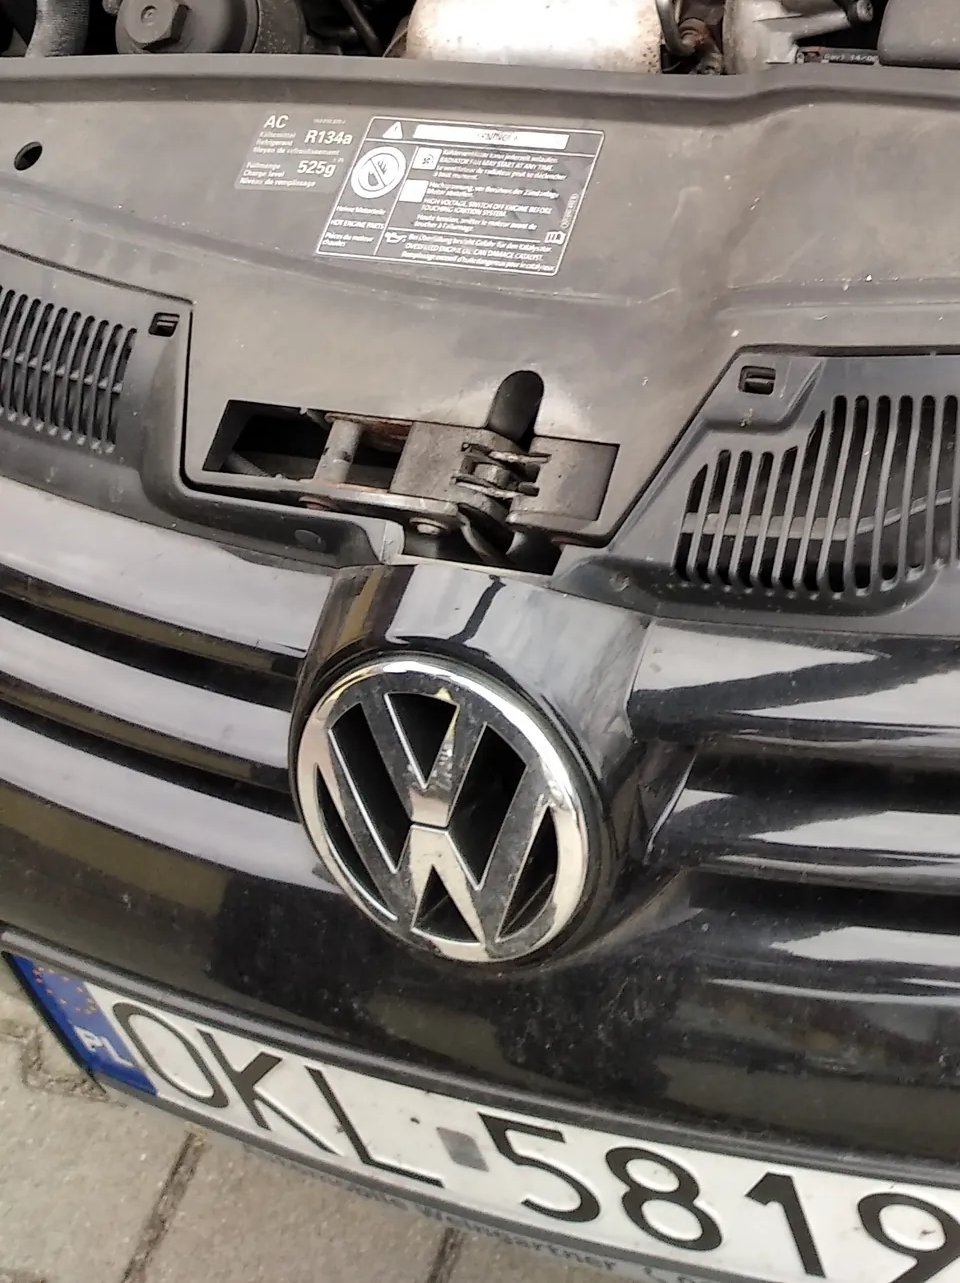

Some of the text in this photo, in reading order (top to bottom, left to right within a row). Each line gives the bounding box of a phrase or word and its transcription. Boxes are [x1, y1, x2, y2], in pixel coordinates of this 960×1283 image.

[263, 114, 289, 129] AC
[304, 129, 353, 145] R134a
[297, 159, 337, 178] 525g
[297, 660, 588, 963] VW
[74, 1027, 135, 1067] PL
[112, 1002, 445, 1188] OKL
